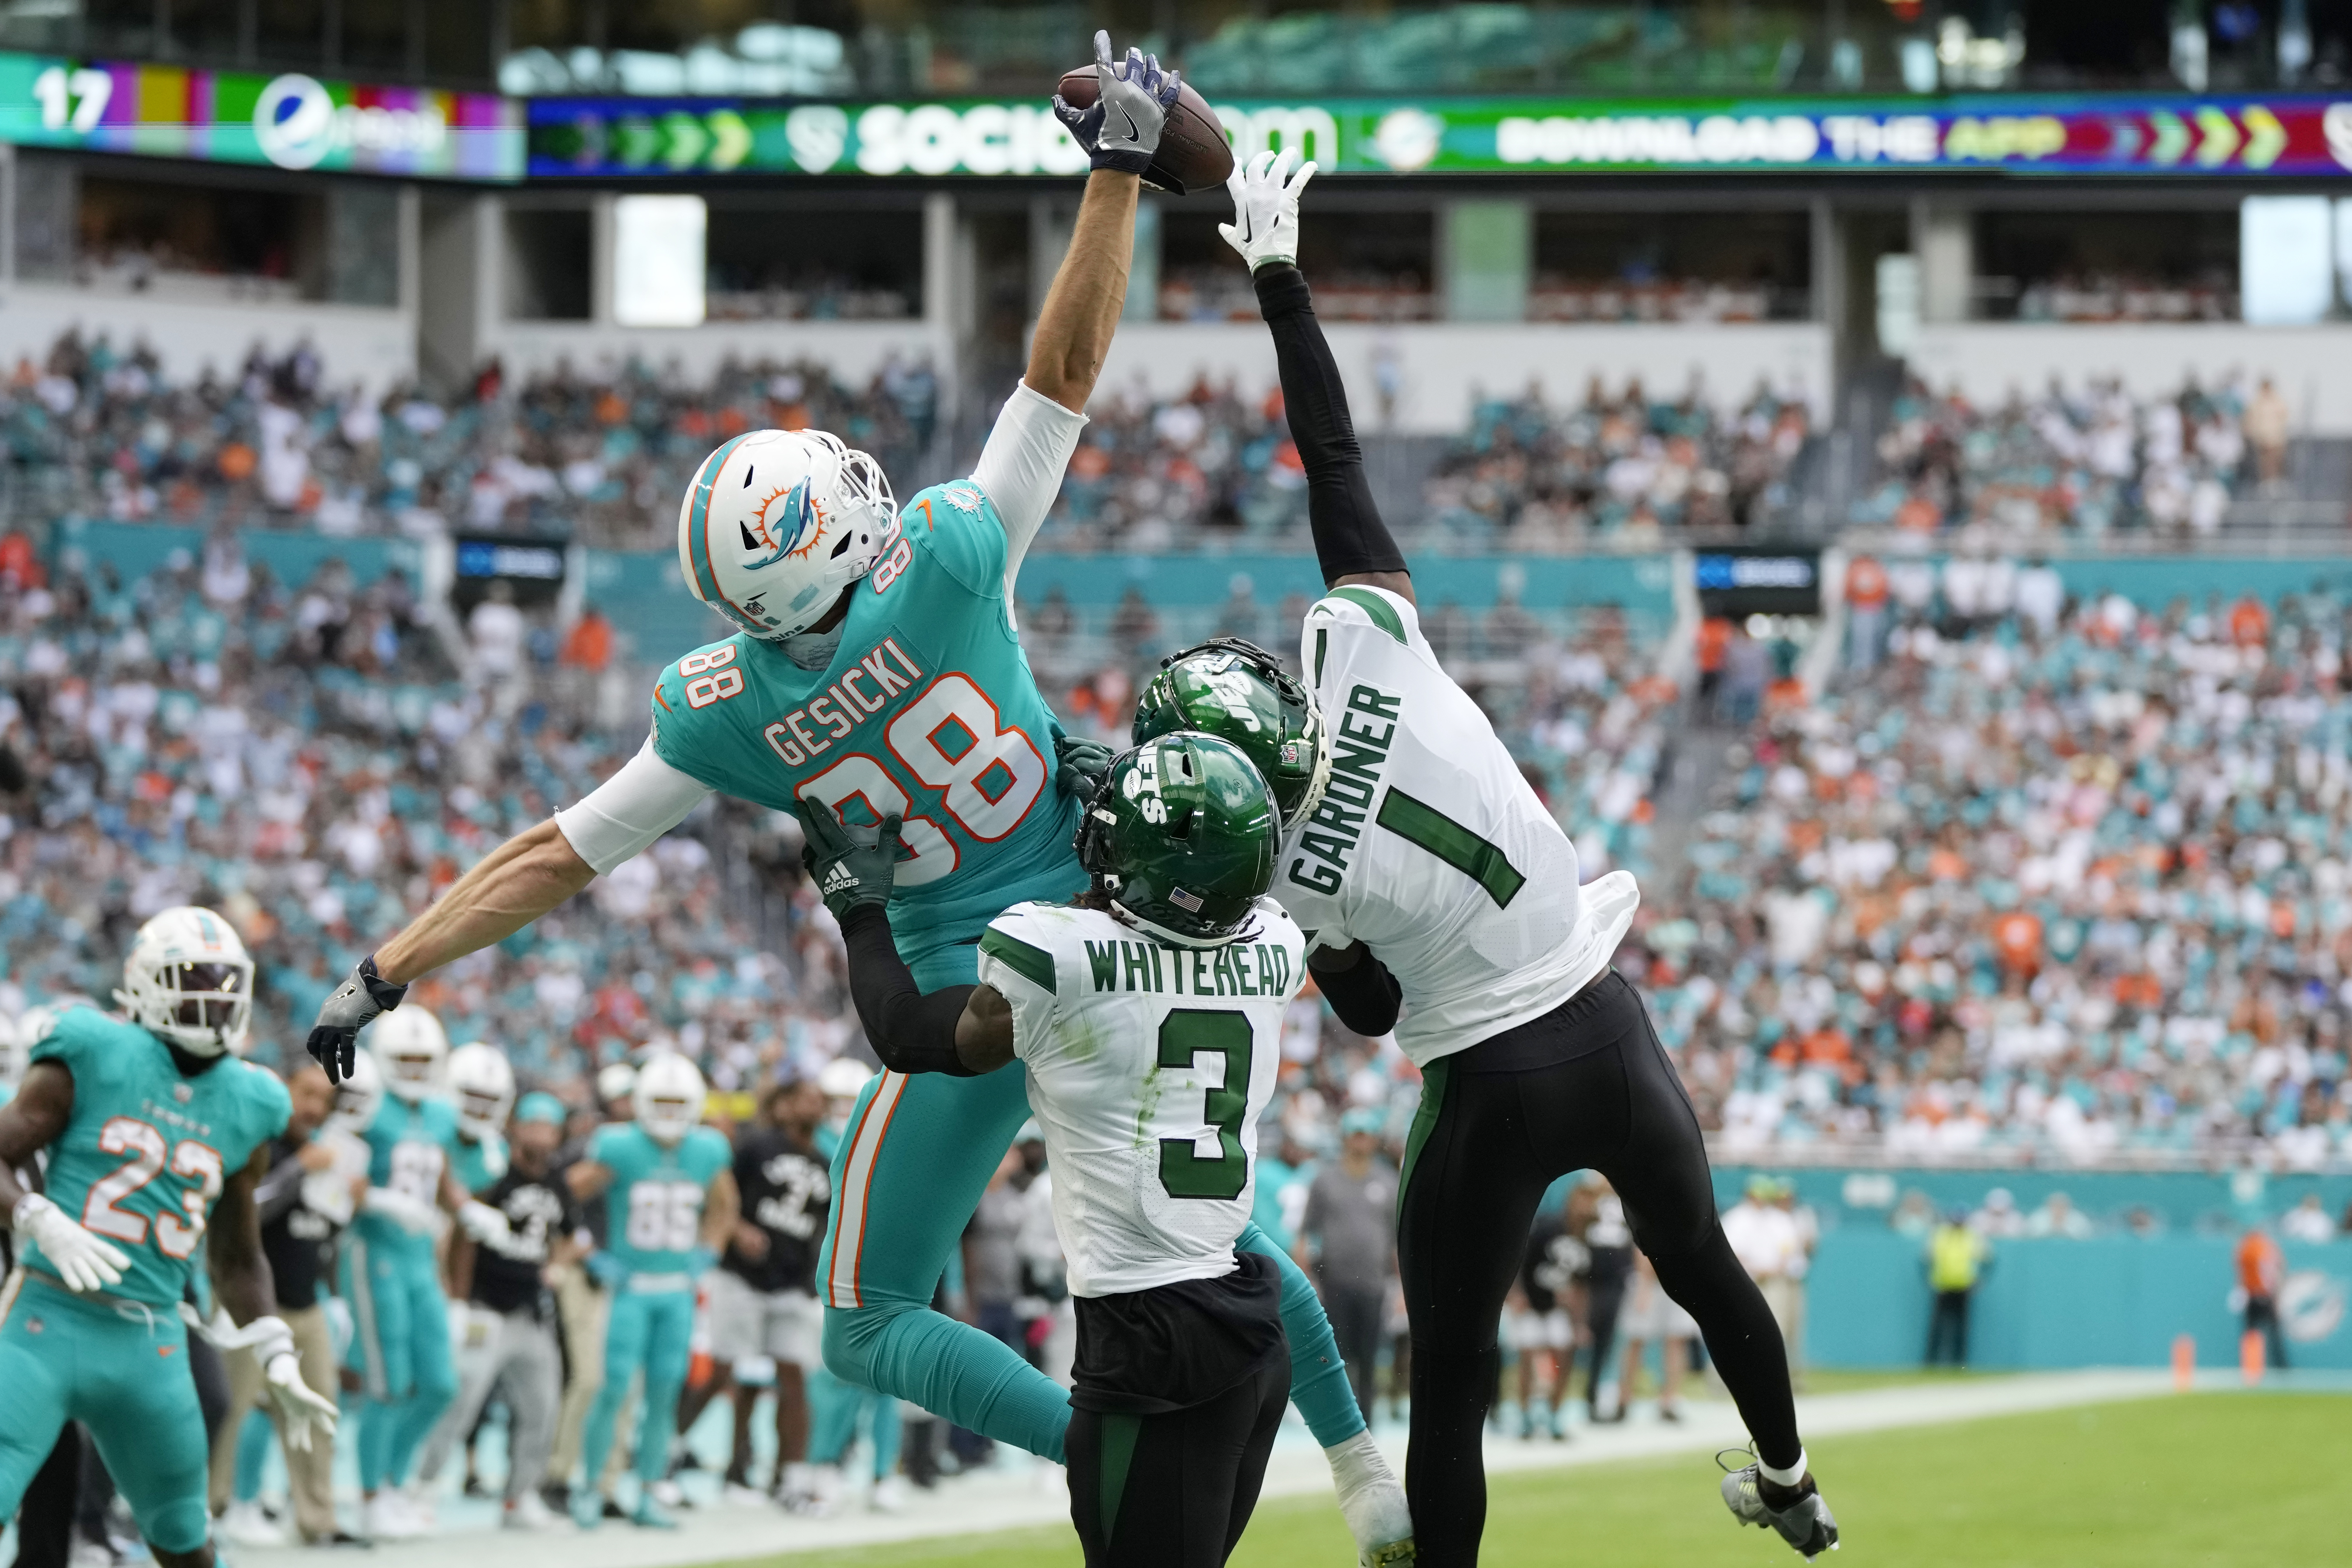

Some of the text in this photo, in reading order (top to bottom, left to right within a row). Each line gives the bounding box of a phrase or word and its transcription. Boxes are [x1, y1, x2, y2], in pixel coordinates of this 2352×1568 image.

[33, 66, 113, 132] 17
[1178, 134, 1208, 153] NATIONAL
[1496, 116, 2066, 163] DOWNLOAD THE APP
[750, 606, 764, 615] NFL
[769, 624, 805, 642] hins
[679, 644, 745, 710] 88
[763, 637, 924, 767] GESICKI
[1183, 659, 1261, 732] JETS
[794, 671, 1048, 886] 88
[1137, 740, 1167, 824] JETS
[1288, 684, 1401, 896] GARDNER
[1313, 783, 1317, 791] US
[1375, 785, 1526, 910] 1
[823, 877, 859, 895] adidas
[1199, 920, 1216, 931] 3
[1084, 939, 1290, 996] WHITEHEAD
[1157, 1008, 1254, 1200] 3
[81, 1116, 224, 1260] 23
